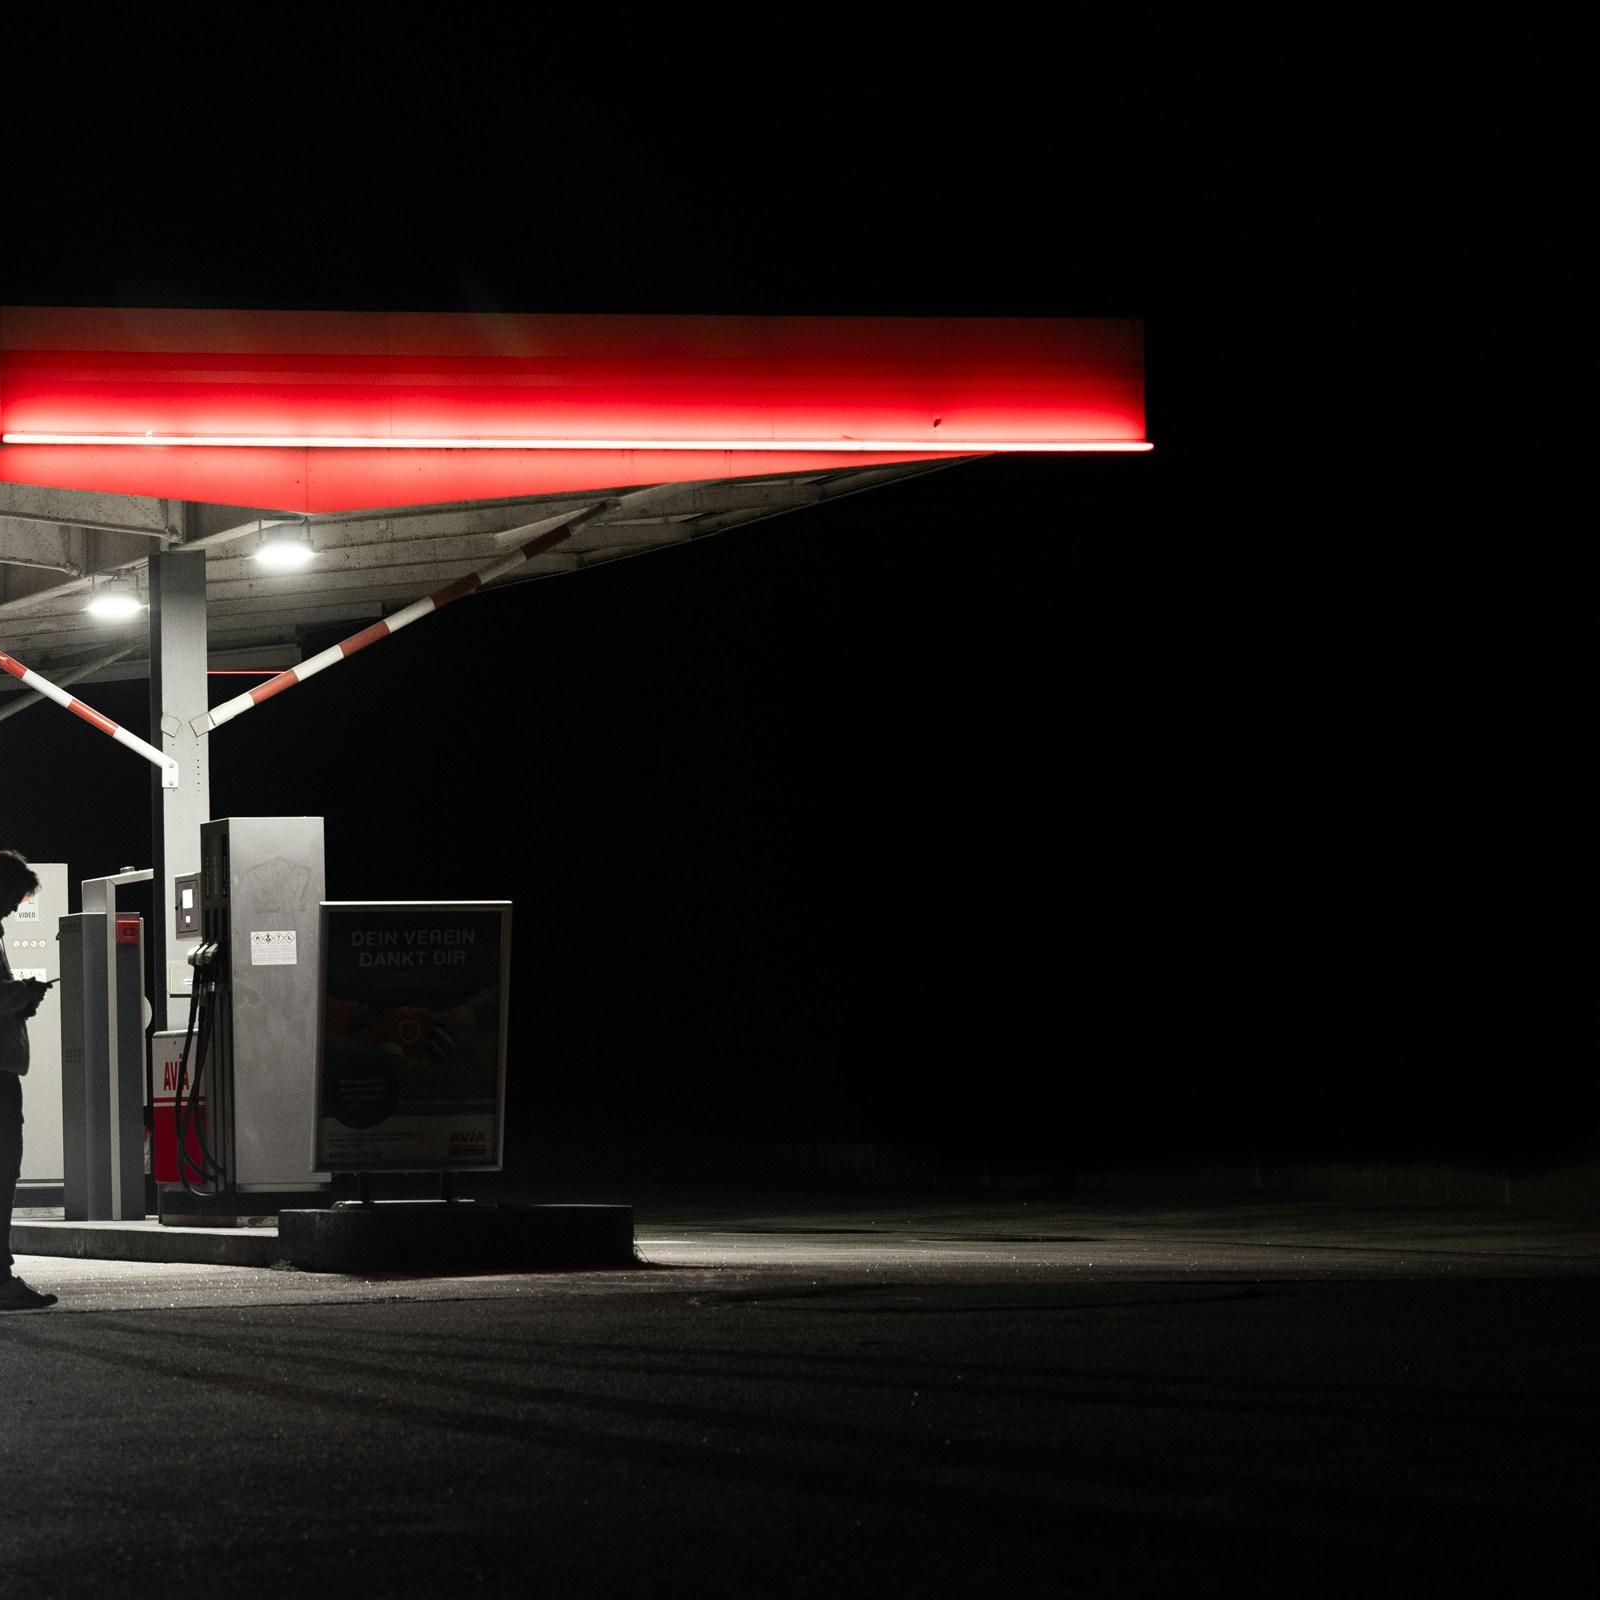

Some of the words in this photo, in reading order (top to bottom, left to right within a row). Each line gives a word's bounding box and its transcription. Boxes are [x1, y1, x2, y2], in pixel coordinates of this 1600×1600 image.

[351, 930, 398, 946] DEIN
[404, 928, 476, 945] VEREIN
[359, 951, 428, 968] DANKT
[432, 949, 467, 966] DIR
